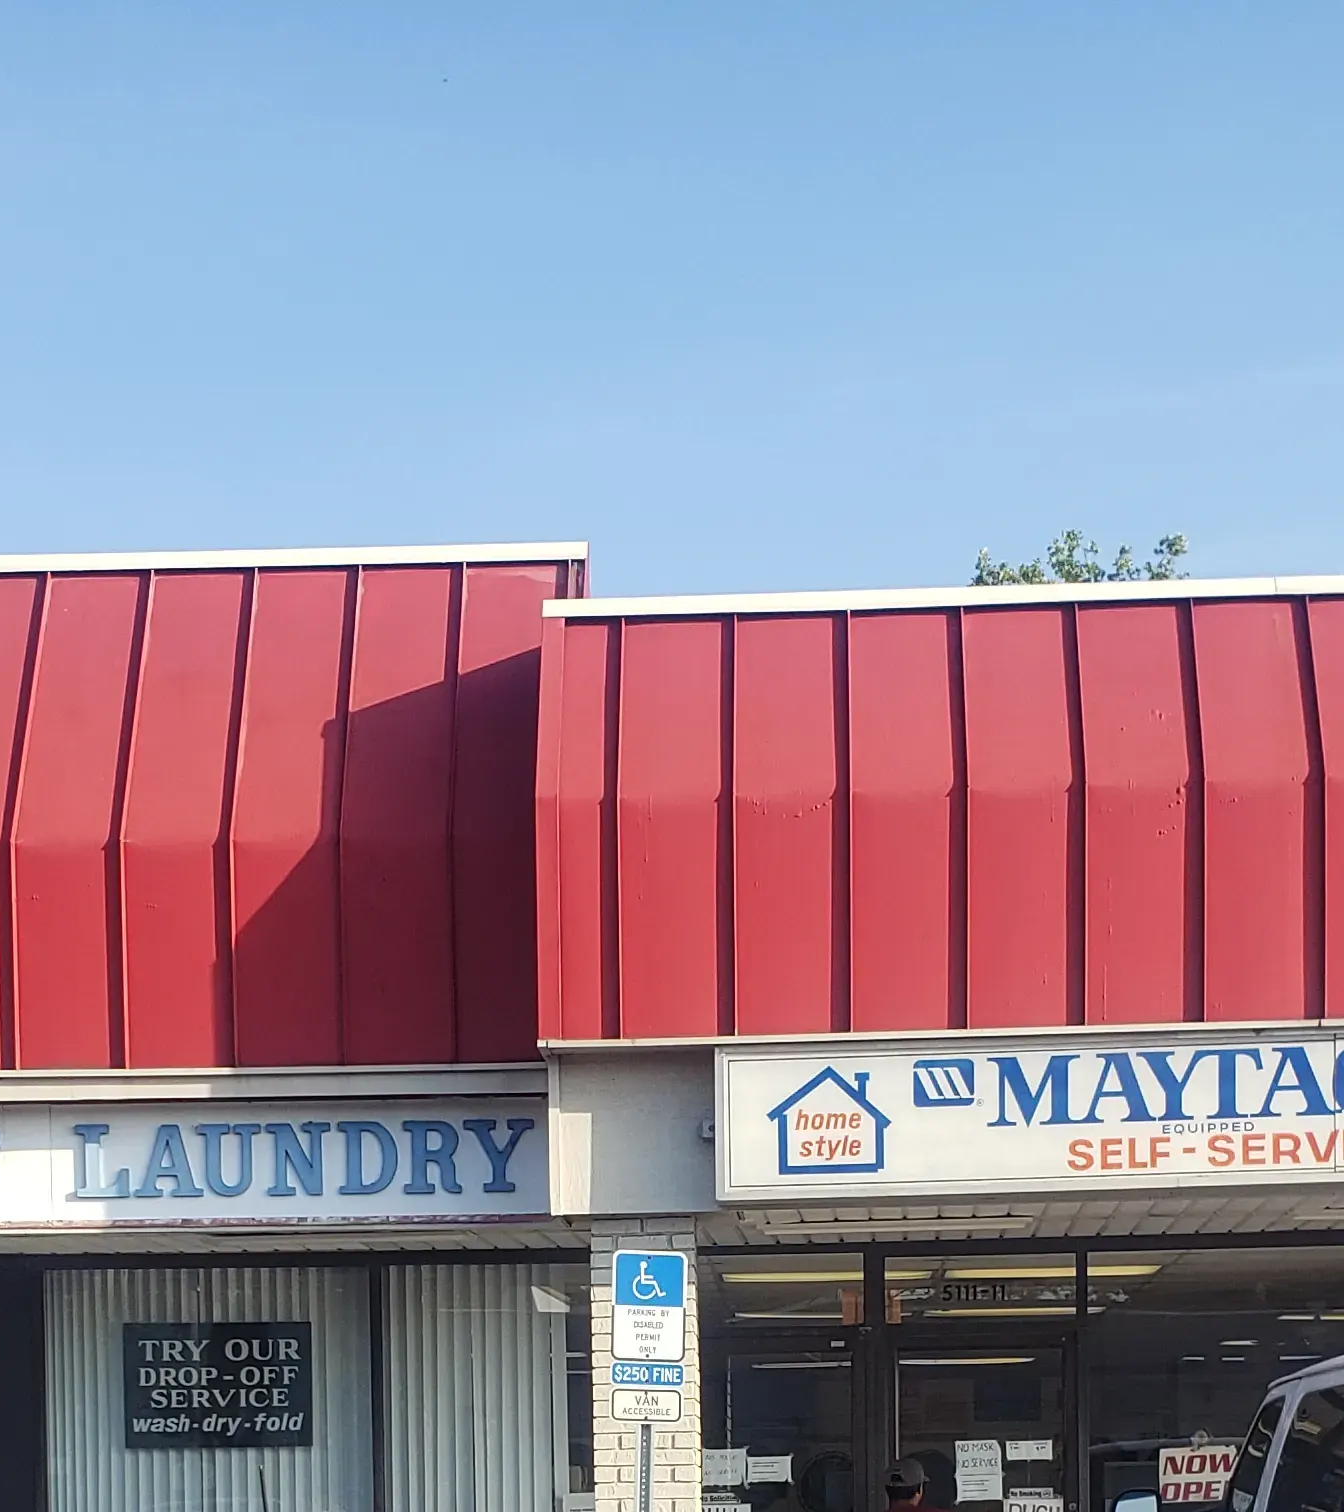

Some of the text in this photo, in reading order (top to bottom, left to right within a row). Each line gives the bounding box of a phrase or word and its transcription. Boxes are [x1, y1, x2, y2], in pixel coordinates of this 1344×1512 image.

[795, 1109, 861, 1130] home
[1162, 1121, 1255, 1134] EQUIPPED
[799, 1135, 861, 1161] style
[71, 1118, 535, 1199] LAUNDRY
[627, 1309, 670, 1317] PARKING BY
[633, 1320, 664, 1329] DISABLED
[635, 1333, 661, 1342] PERMIT
[138, 1338, 302, 1362] TRY OUR
[639, 1346, 657, 1354] ONLY
[138, 1366, 299, 1387] DROP-OFF
[614, 1365, 681, 1382] $250 FINE
[150, 1388, 289, 1409] SERVICE
[635, 1396, 659, 1406] VAN
[623, 1407, 671, 1416] ACCESSIBLE
[133, 1412, 304, 1436] wash-dry-fold
[957, 1443, 994, 1452] NO MASK
[958, 1458, 998, 1468] NO SERVICE
[1162, 1453, 1236, 1476] NOW
[1161, 1480, 1222, 1501] OPE
